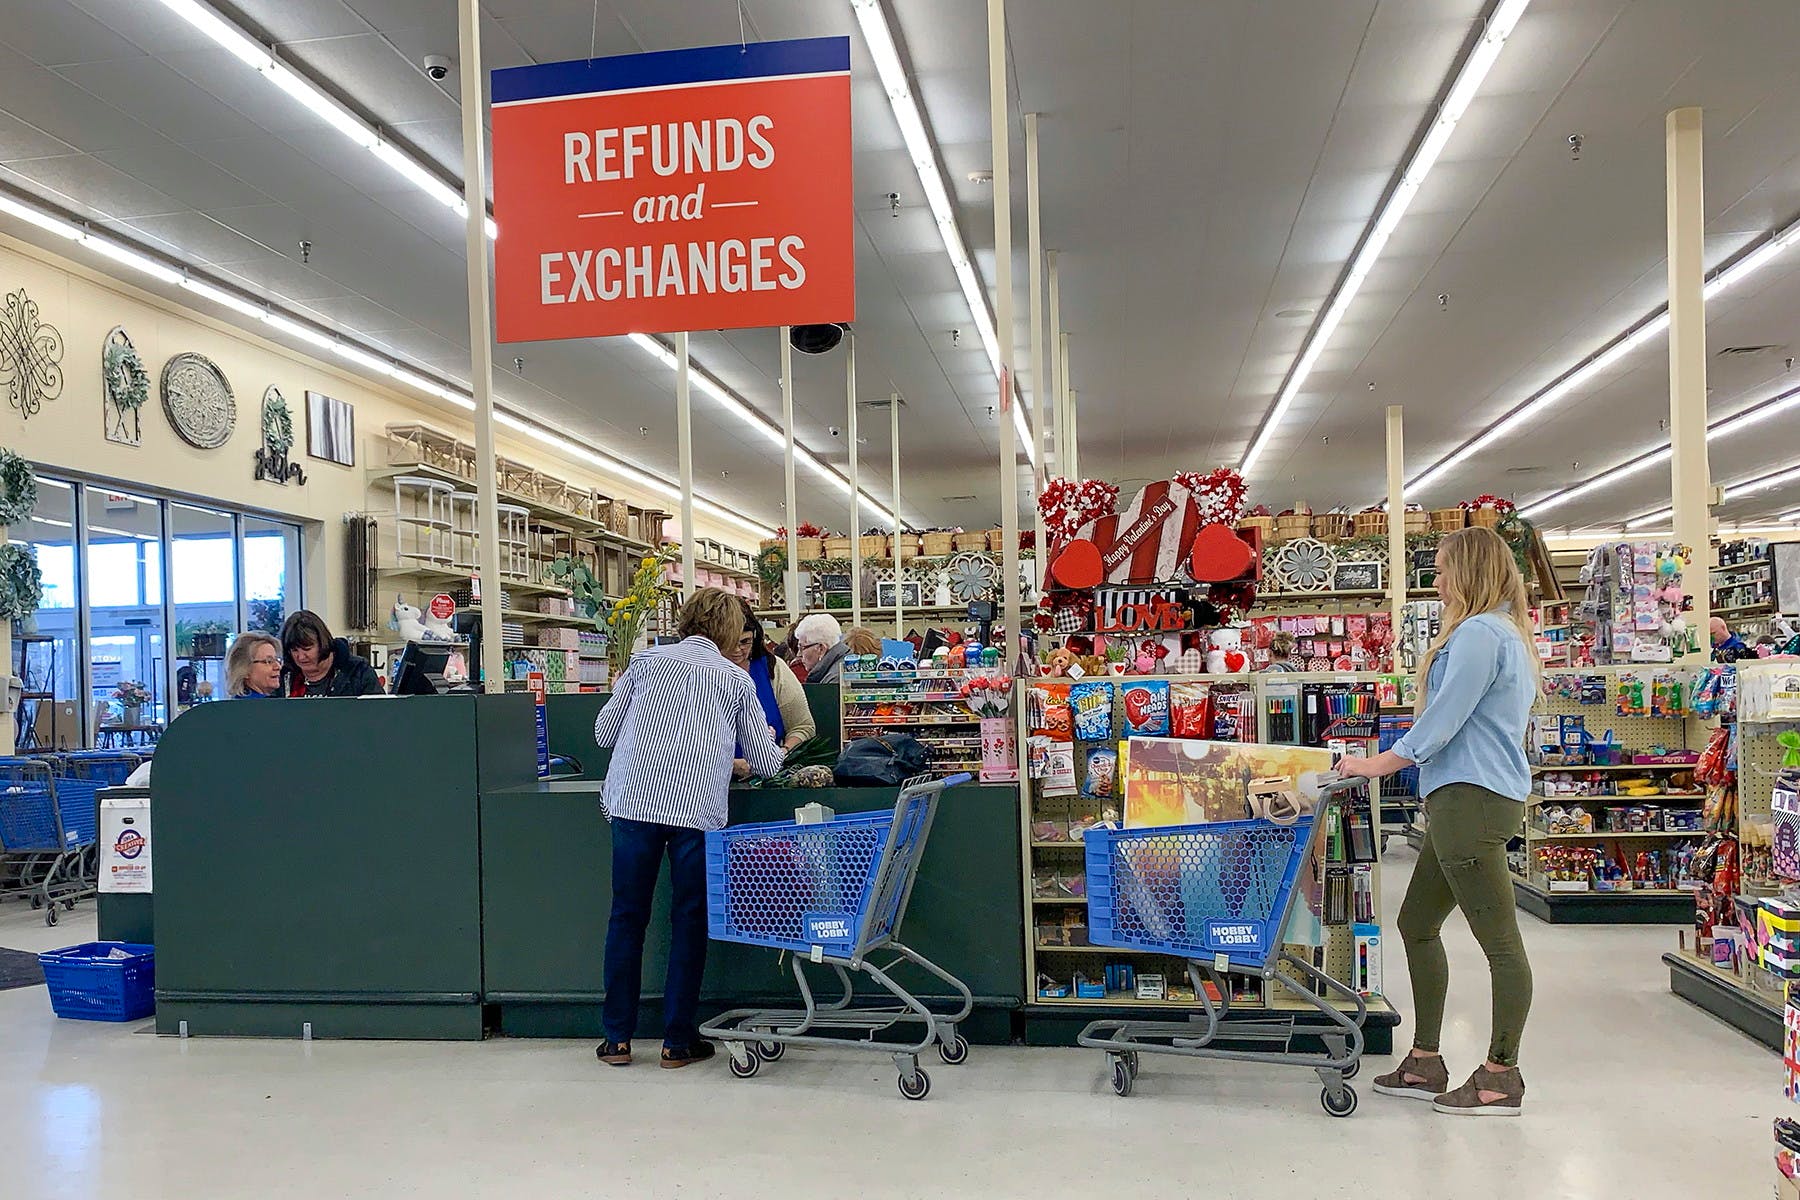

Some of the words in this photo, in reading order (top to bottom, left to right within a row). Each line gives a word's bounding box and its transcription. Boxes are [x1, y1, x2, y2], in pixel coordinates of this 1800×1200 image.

[564, 115, 776, 184] REFUNDS
[632, 183, 706, 224] and
[540, 235, 806, 305] EXCHANGES
[1103, 543, 1130, 567] Happy
[1123, 514, 1158, 546] Valentine's
[1152, 500, 1173, 518] Day
[1094, 602, 1184, 633] LOVE
[1150, 687, 1168, 702] AIR
[1140, 701, 1168, 716] HEADS
[811, 920, 845, 931] HOBBY
[1212, 925, 1253, 937] HOBBY
[817, 928, 849, 939] LOBBY
[1219, 934, 1258, 944] LOBBY
